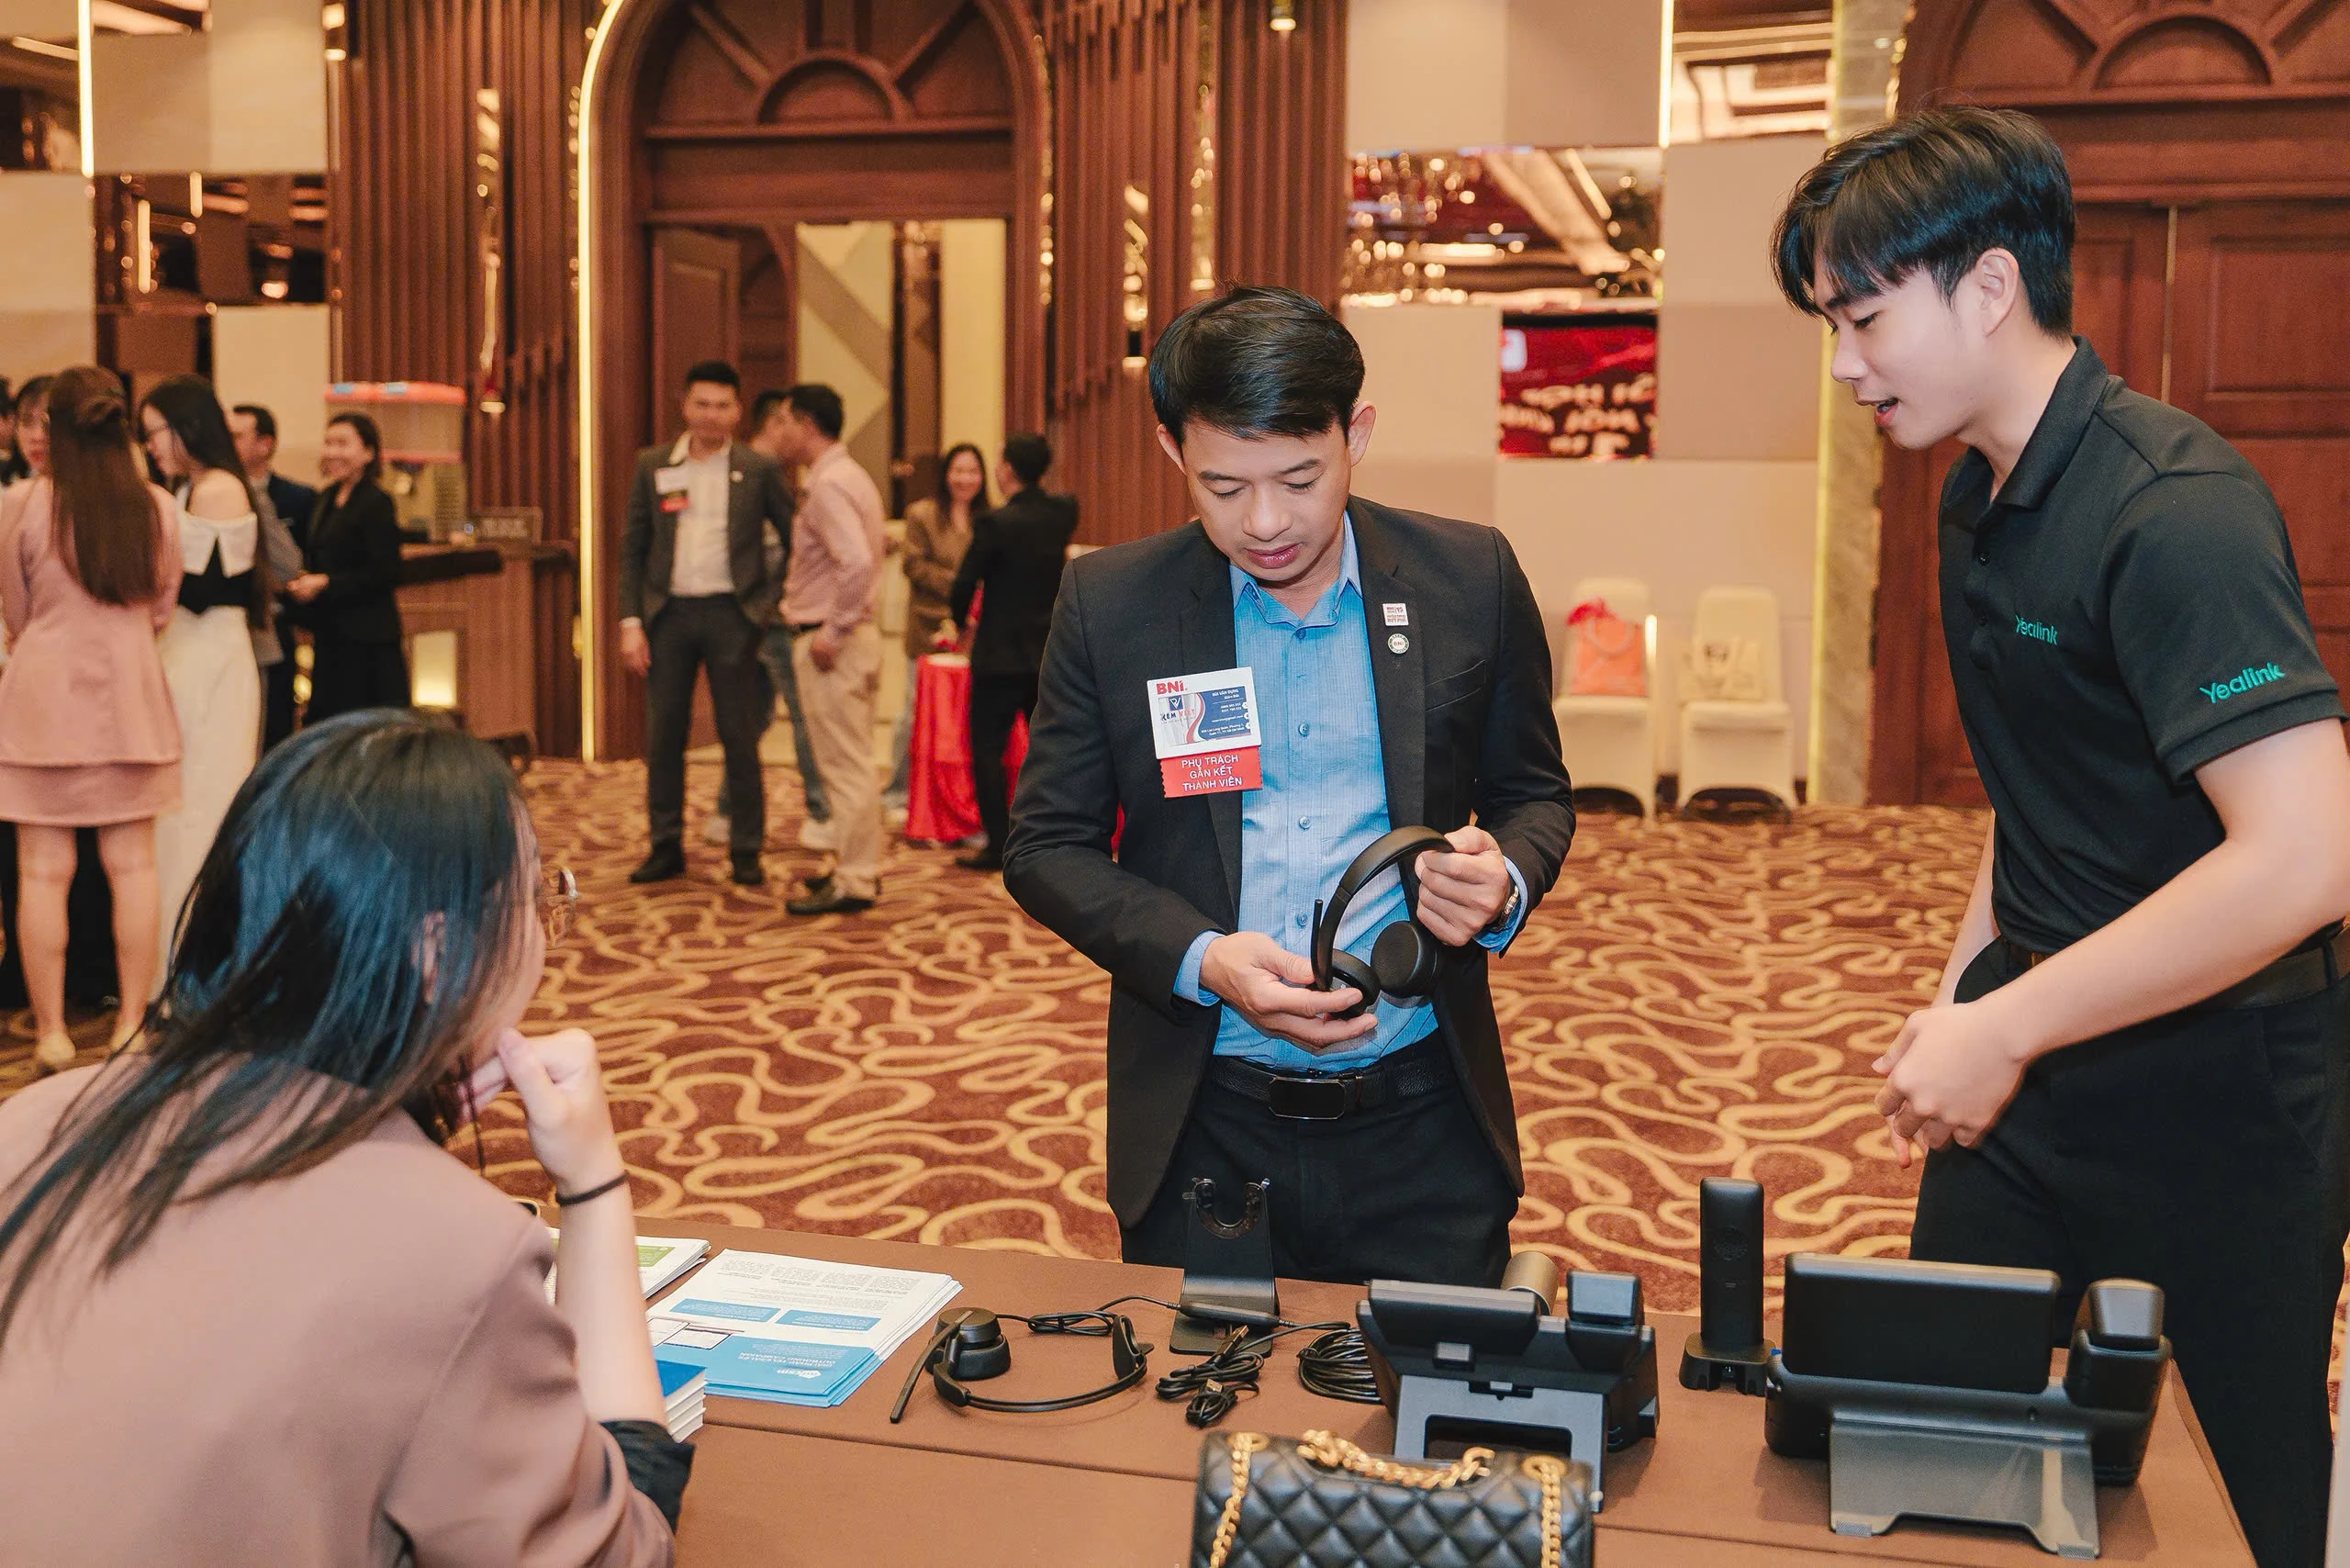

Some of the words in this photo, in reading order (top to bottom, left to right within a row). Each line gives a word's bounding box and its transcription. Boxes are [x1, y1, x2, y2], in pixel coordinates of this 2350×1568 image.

[2015, 614, 2058, 645] Yealink
[2199, 661, 2286, 704] Yealink
[1181, 757, 1203, 769] PHỤ
[1204, 754, 1239, 766] TRÁCH
[1214, 765, 1233, 777] KẾT
[1182, 779, 1216, 791] THÀNH
[1219, 777, 1243, 788] VIÊN
